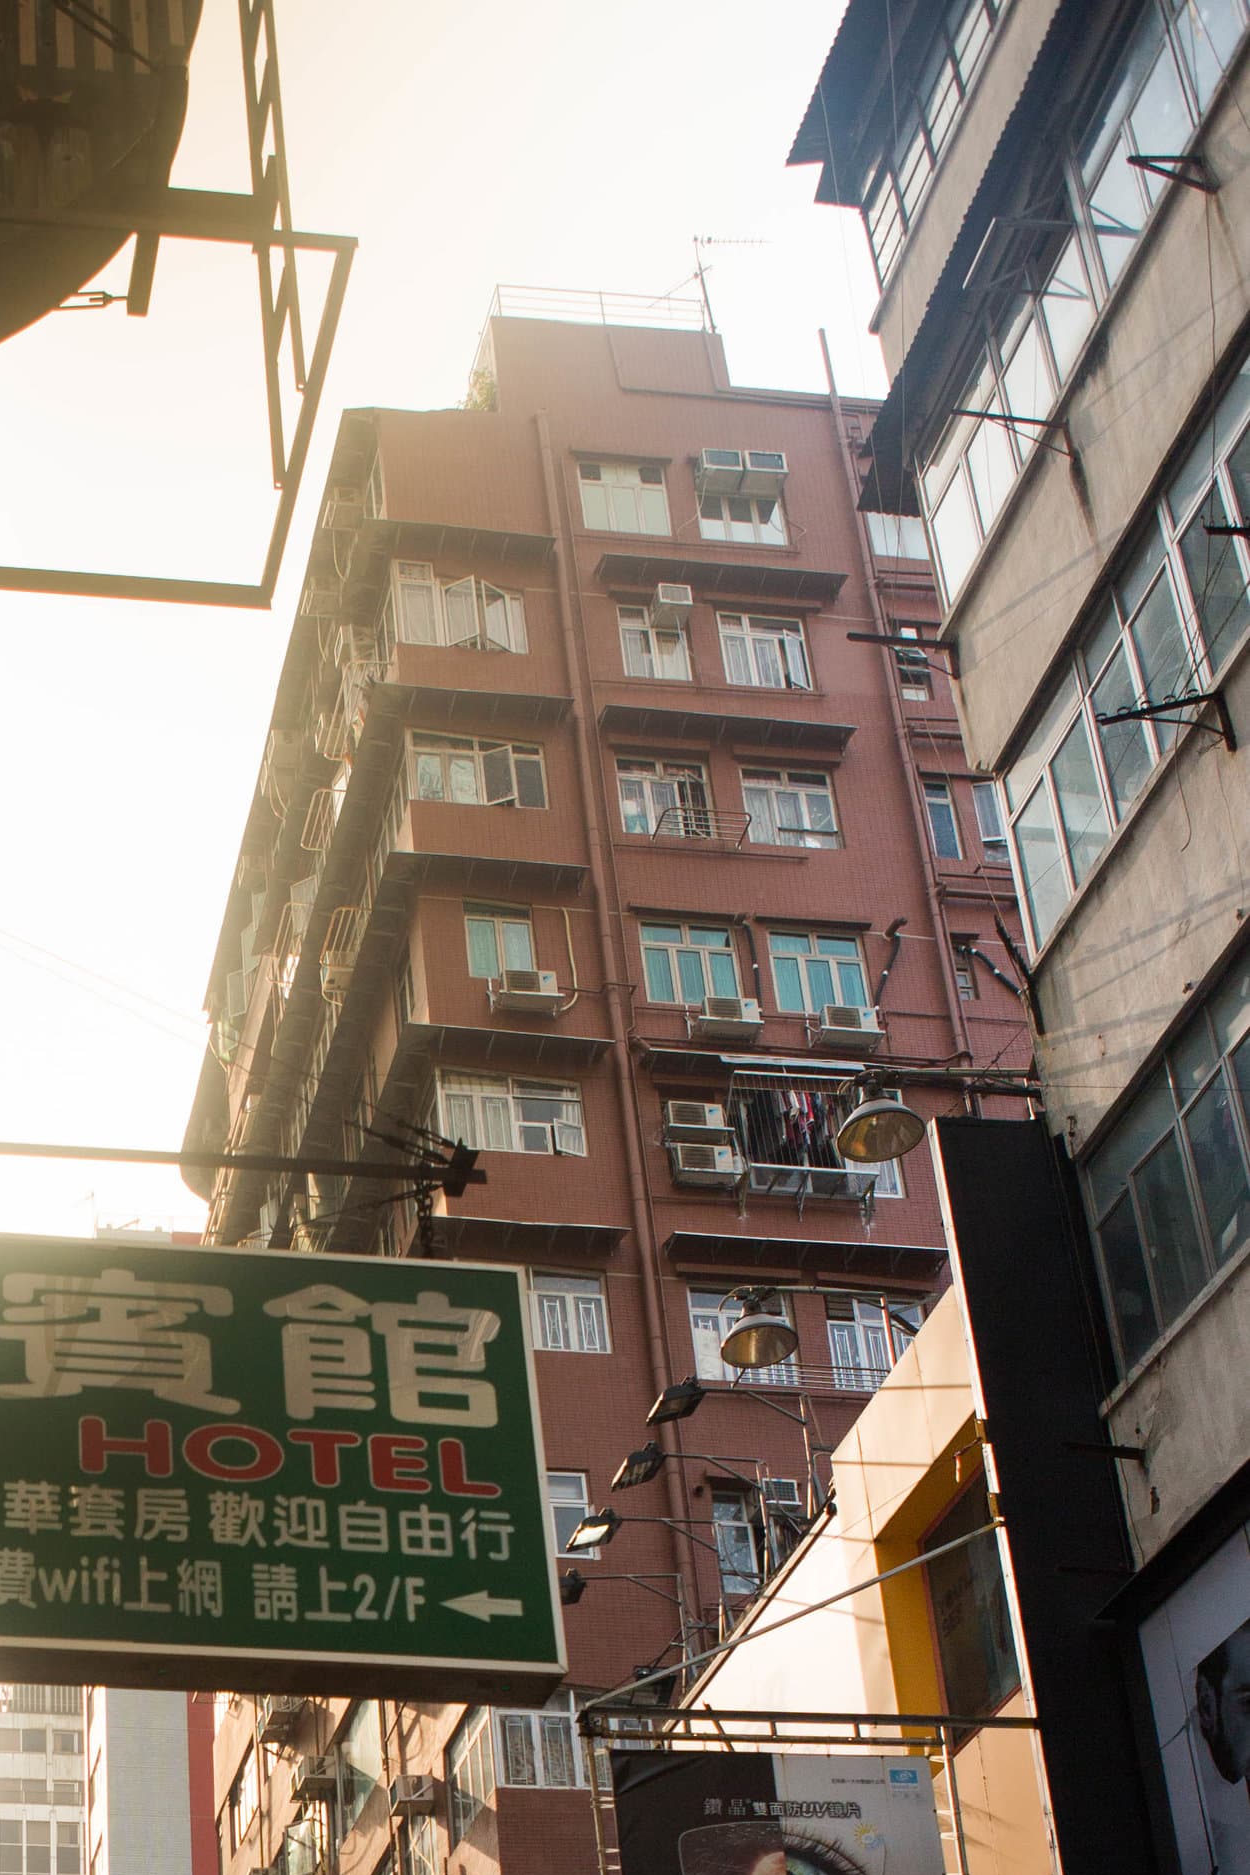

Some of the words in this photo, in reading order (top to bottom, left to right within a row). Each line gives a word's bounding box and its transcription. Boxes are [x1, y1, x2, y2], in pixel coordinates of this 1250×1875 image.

[78, 1415, 502, 1499] HOTEL
[206, 1490, 515, 1562] 歡迎自由行
